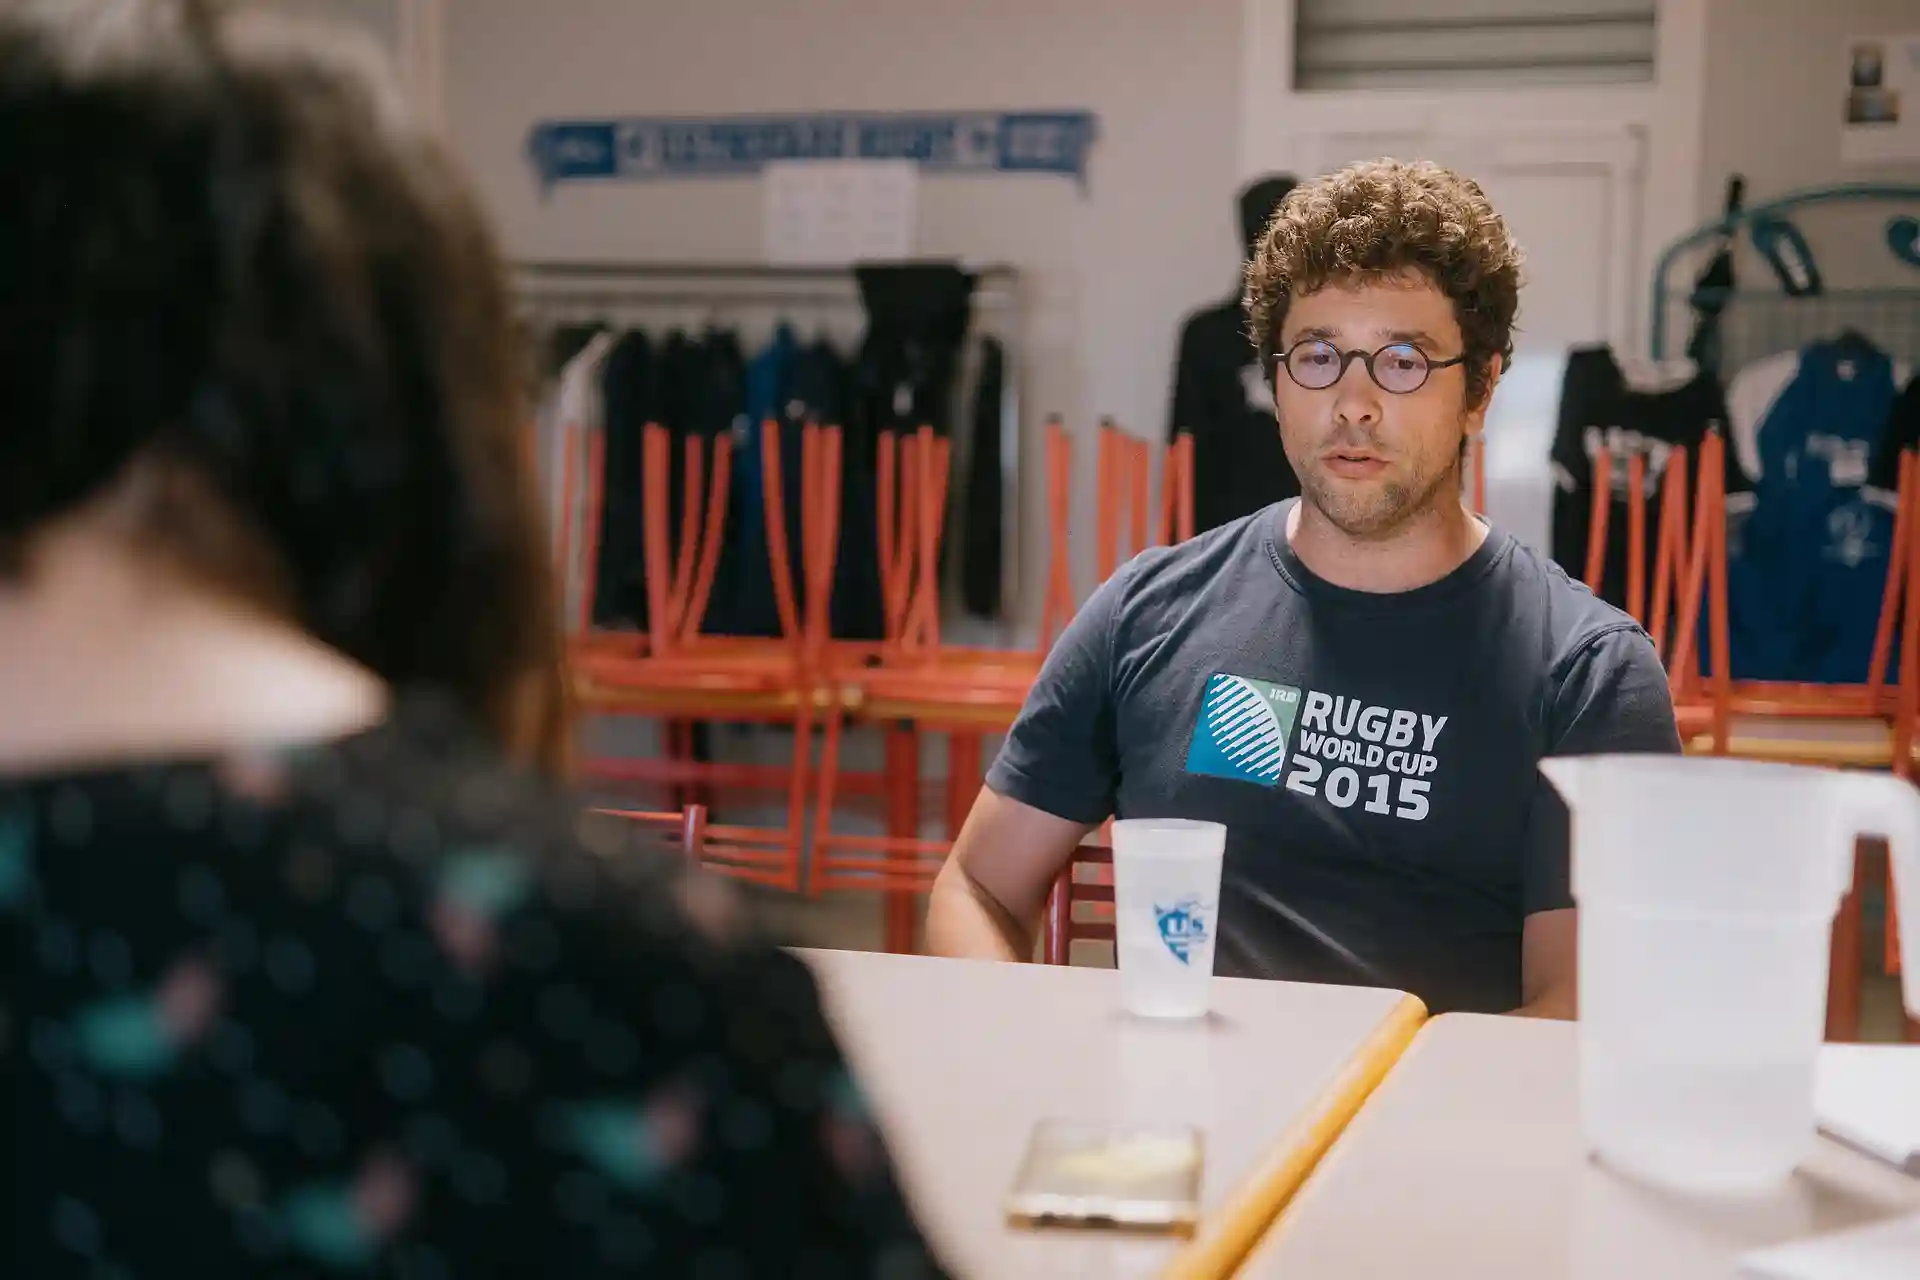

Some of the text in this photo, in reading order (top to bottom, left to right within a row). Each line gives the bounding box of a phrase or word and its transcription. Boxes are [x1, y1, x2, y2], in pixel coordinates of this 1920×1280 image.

[1269, 688, 1298, 703] IRB
[1301, 690, 1448, 751] RUGBY
[1301, 729, 1438, 776] WORLD CUP
[1286, 753, 1432, 821] 2015
